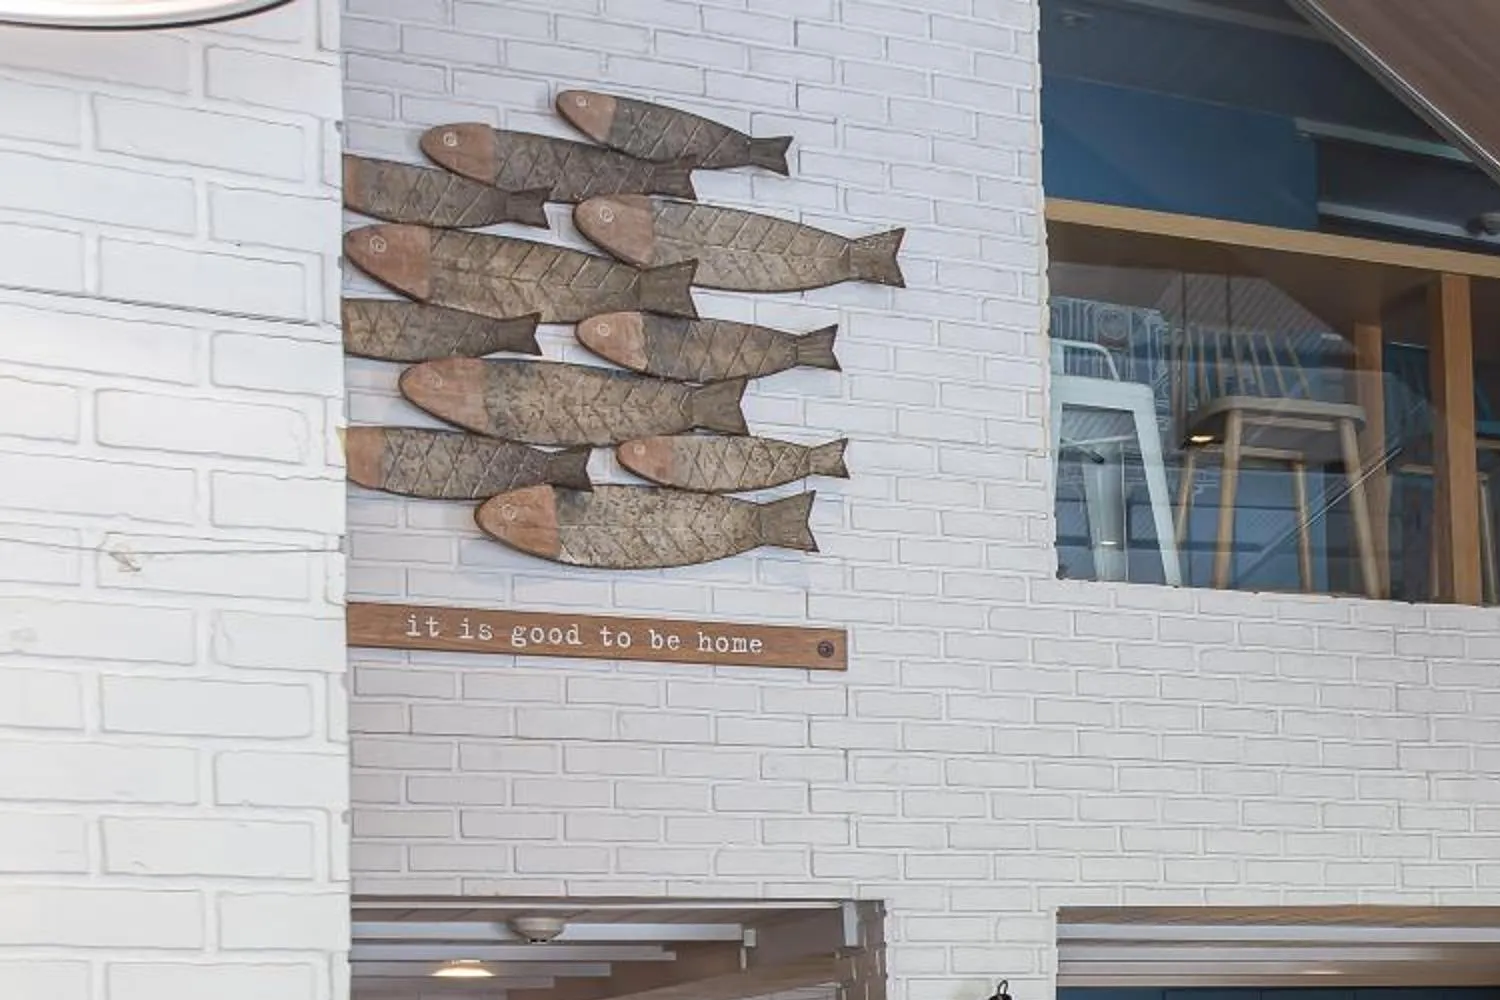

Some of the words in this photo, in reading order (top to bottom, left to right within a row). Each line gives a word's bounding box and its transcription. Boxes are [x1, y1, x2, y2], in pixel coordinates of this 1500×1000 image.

[405, 613, 440, 639] it
[458, 618, 493, 641] is
[510, 625, 583, 648] good
[598, 624, 632, 648] to
[649, 630, 680, 650] be
[695, 632, 765, 654] home
